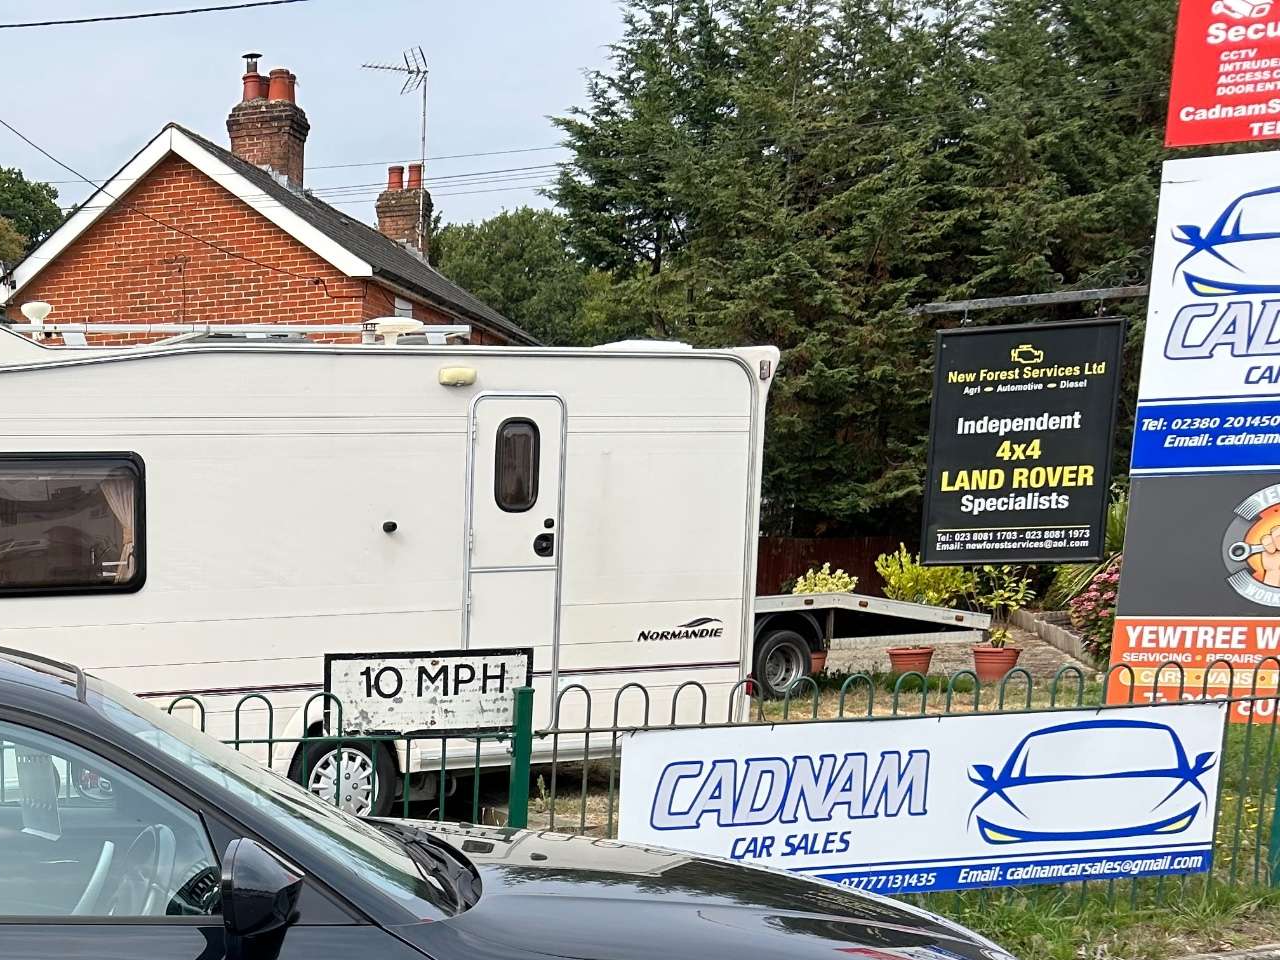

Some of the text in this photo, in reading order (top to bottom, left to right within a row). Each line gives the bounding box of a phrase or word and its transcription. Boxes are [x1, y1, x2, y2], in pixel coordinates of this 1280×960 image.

[1206, 21, 1280, 45] Secu
[1220, 48, 1258, 61] CCTV
[1217, 69, 1271, 84] ACCESS
[1216, 83, 1254, 96] DOOR
[948, 362, 1106, 383] New Forest Services Ltd
[963, 379, 1087, 396] Agri Automotive Diesel
[957, 411, 1081, 436] Independent
[1141, 418, 1167, 431] Tel:
[1171, 417, 1220, 430] 02380
[996, 439, 1041, 461] 4x4
[1163, 433, 1213, 448] Email:
[940, 465, 1094, 492] LAND ROVER
[960, 492, 1069, 515] Specialists
[936, 539, 1089, 551] Email: newforestservices@aol.com
[937, 533, 952, 542] Tel:
[955, 532, 970, 541] 023
[1026, 531, 1042, 539] 023
[1044, 530, 1065, 539] 8081
[1068, 529, 1090, 538] 1973
[637, 628, 723, 642] NORMANDIE
[1126, 625, 1248, 649] YEWTREE
[1122, 652, 1263, 664] SERVICING REPAIRS
[360, 663, 506, 698] 10 MPH
[650, 749, 930, 831] CADNAM
[730, 831, 851, 859] CAR SALES
[958, 866, 1003, 883] Email:
[1006, 855, 1202, 880] cadnamcarsales@gmail.com
